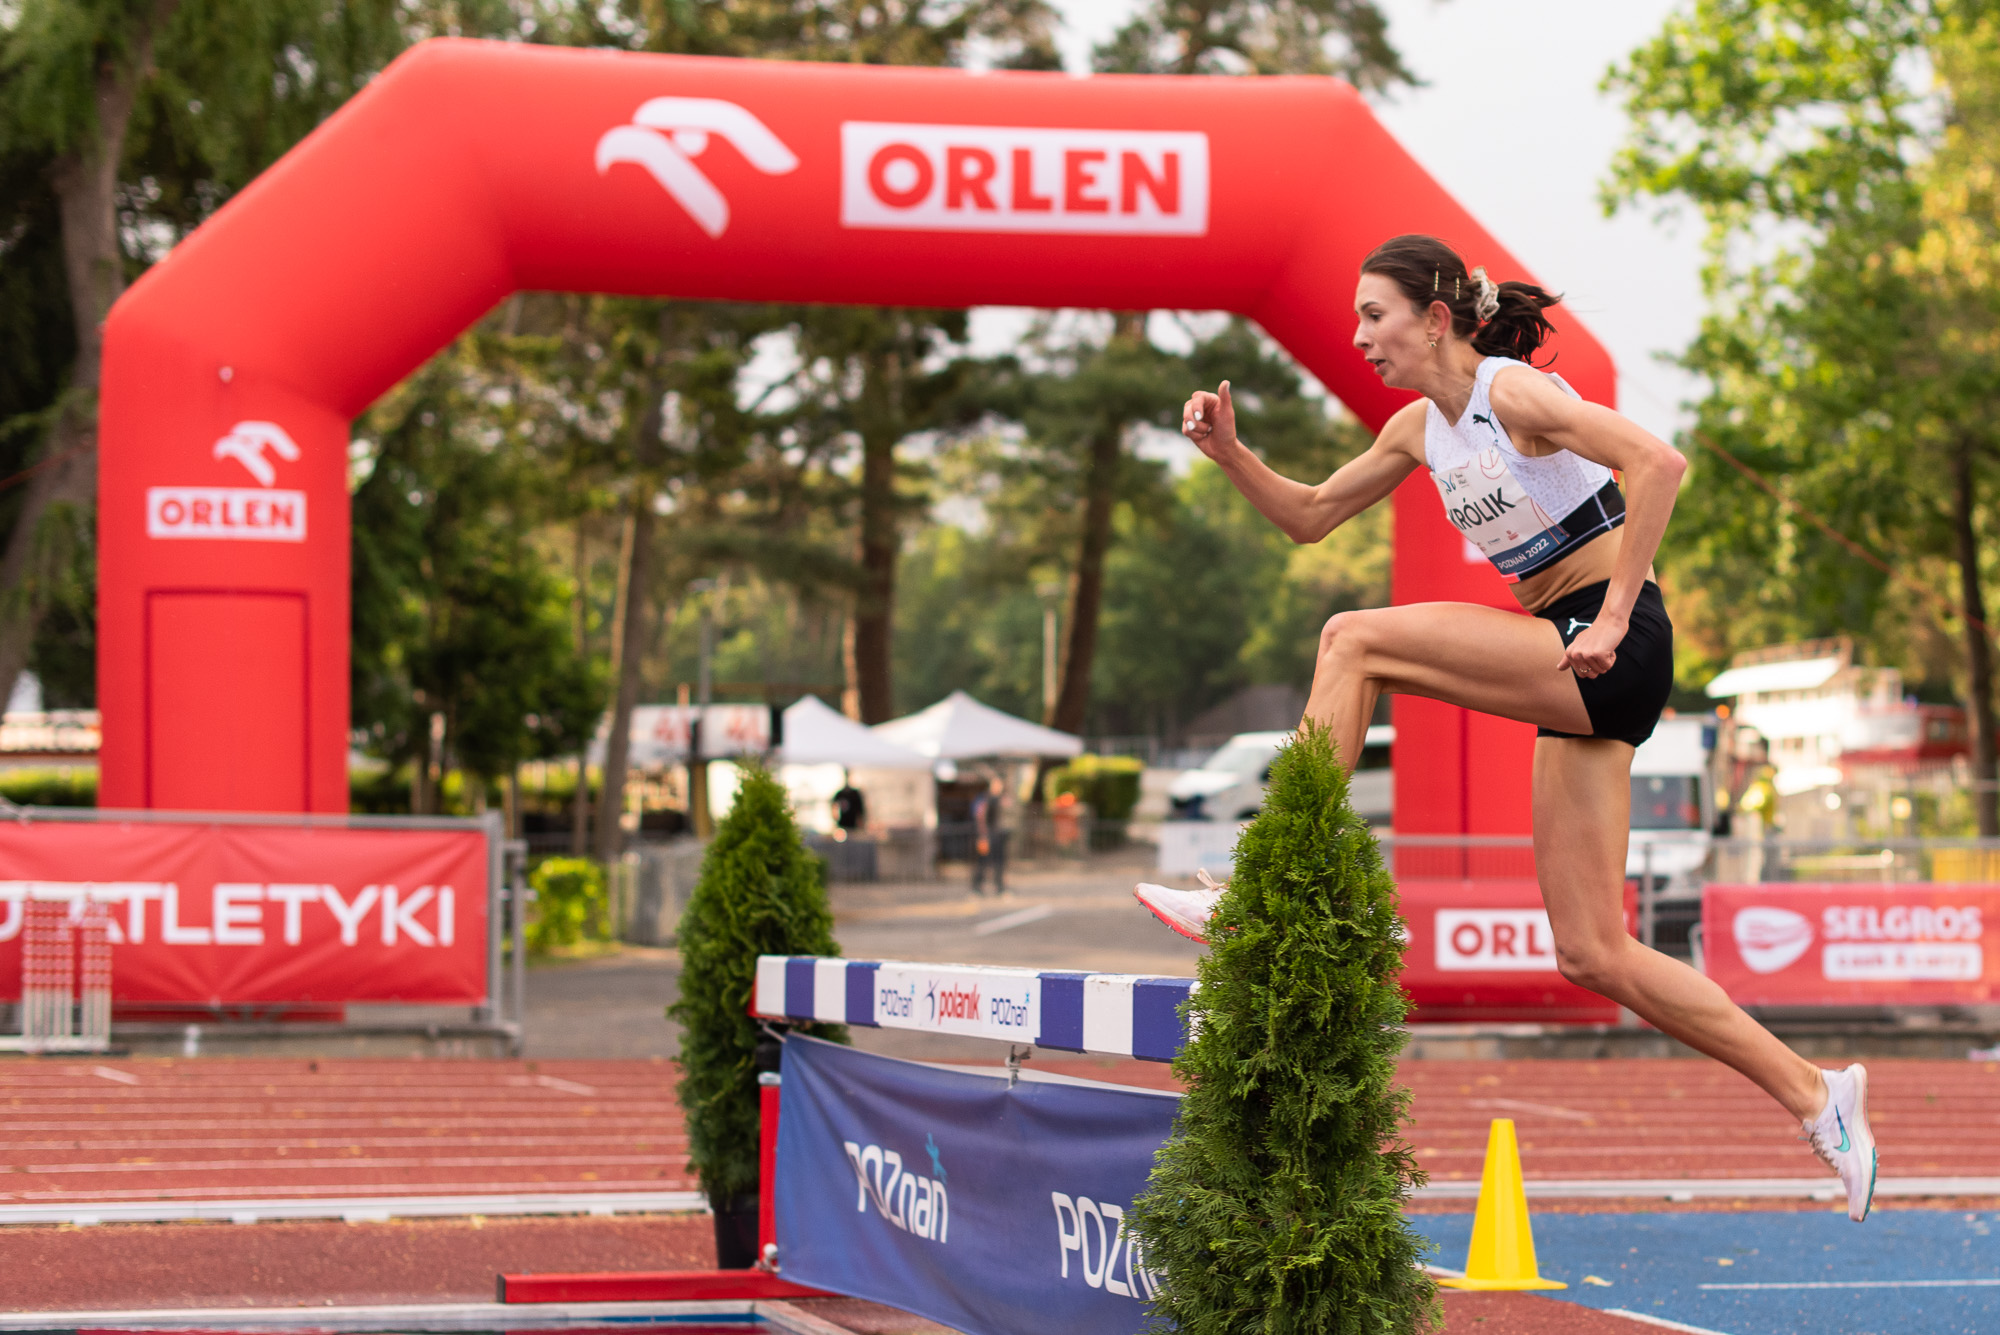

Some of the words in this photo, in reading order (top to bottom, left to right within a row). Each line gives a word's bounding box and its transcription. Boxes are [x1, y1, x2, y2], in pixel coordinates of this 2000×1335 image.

[866, 142, 1181, 218] ORLEN
[160, 498, 294, 527] ORLEN
[1448, 486, 1516, 531] KRÓLIK
[1498, 553, 1527, 569] POZNAŃ
[1526, 538, 1549, 557] 2022
[1451, 923, 1556, 957] ORL
[1822, 906, 1984, 940] SELGROS
[938, 983, 980, 1026] polanik
